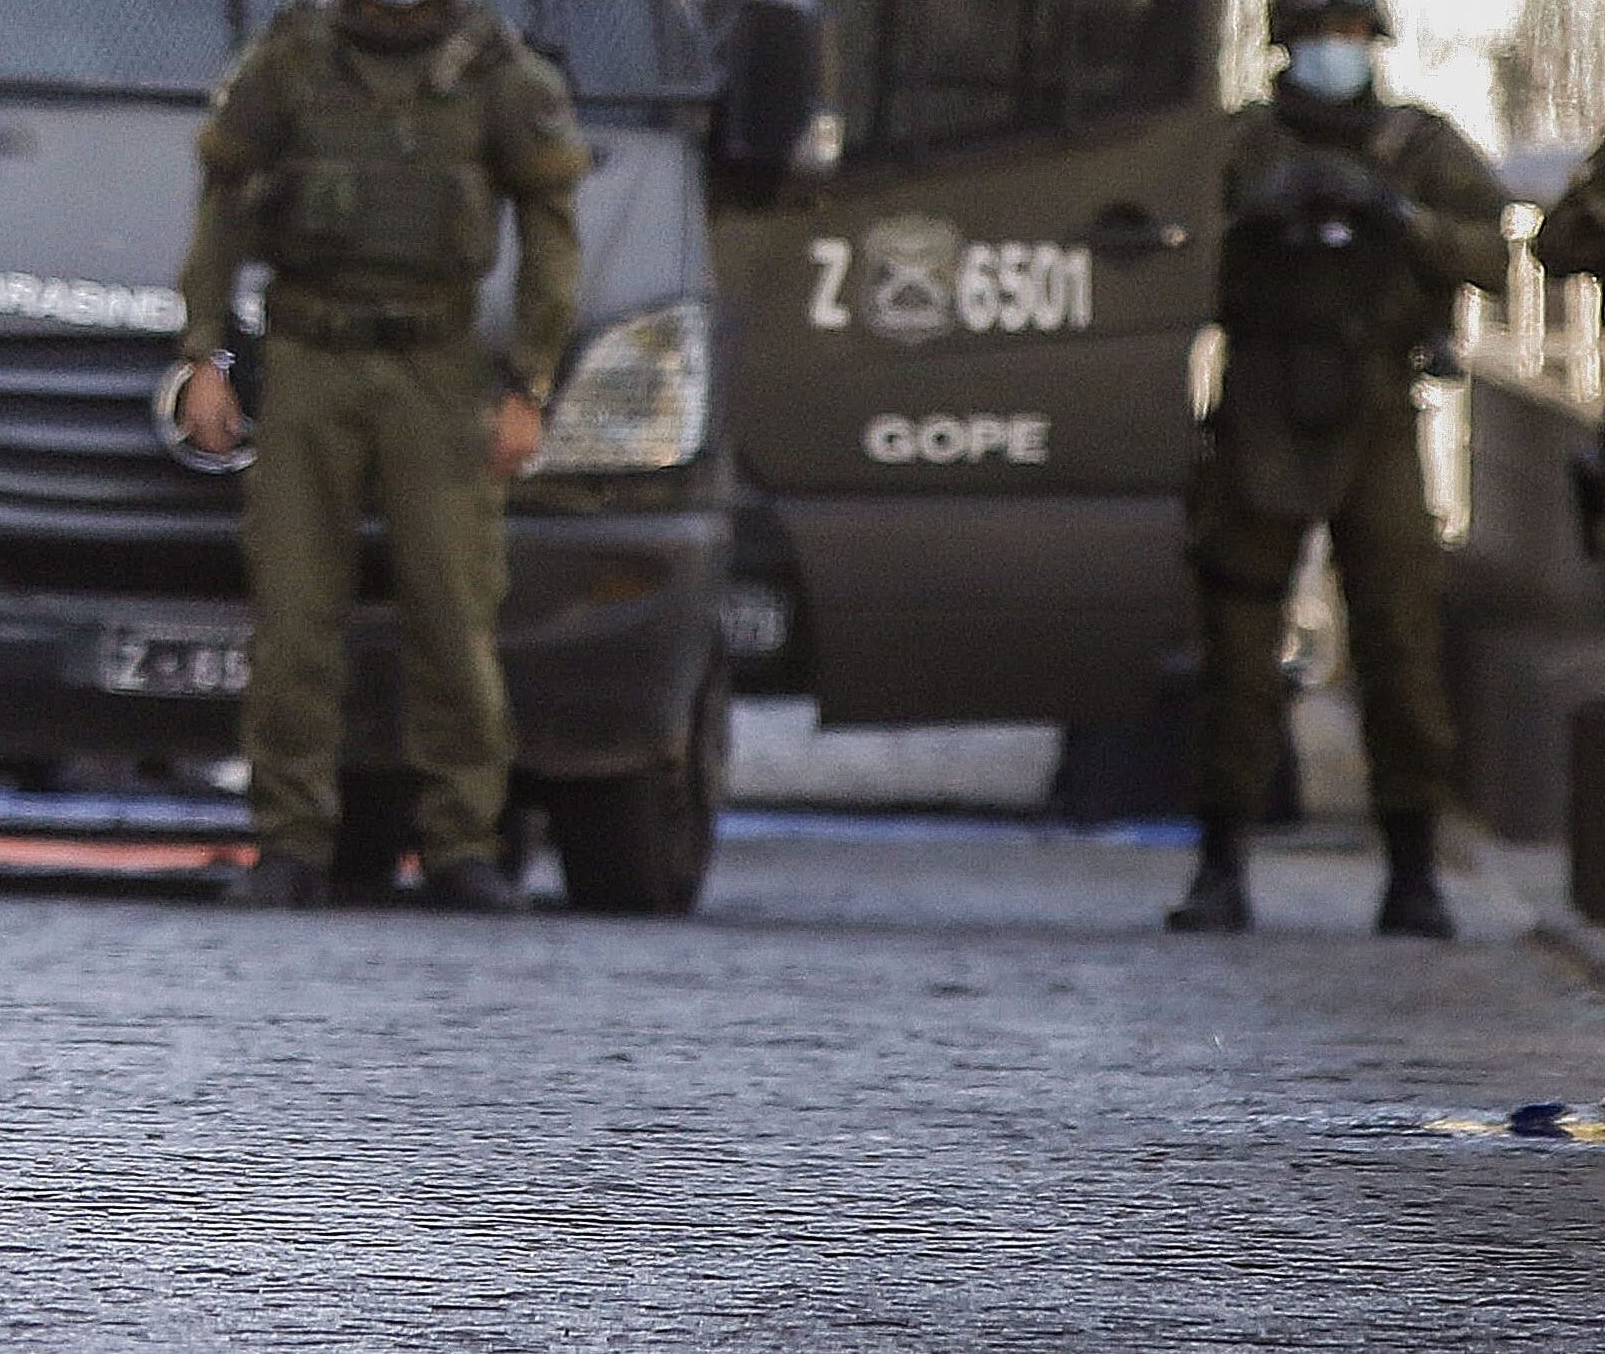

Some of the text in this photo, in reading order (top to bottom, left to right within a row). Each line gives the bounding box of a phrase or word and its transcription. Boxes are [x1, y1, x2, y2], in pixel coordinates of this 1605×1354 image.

[808, 237, 1092, 332] Z 6501
[864, 413, 1050, 463] GOPE
